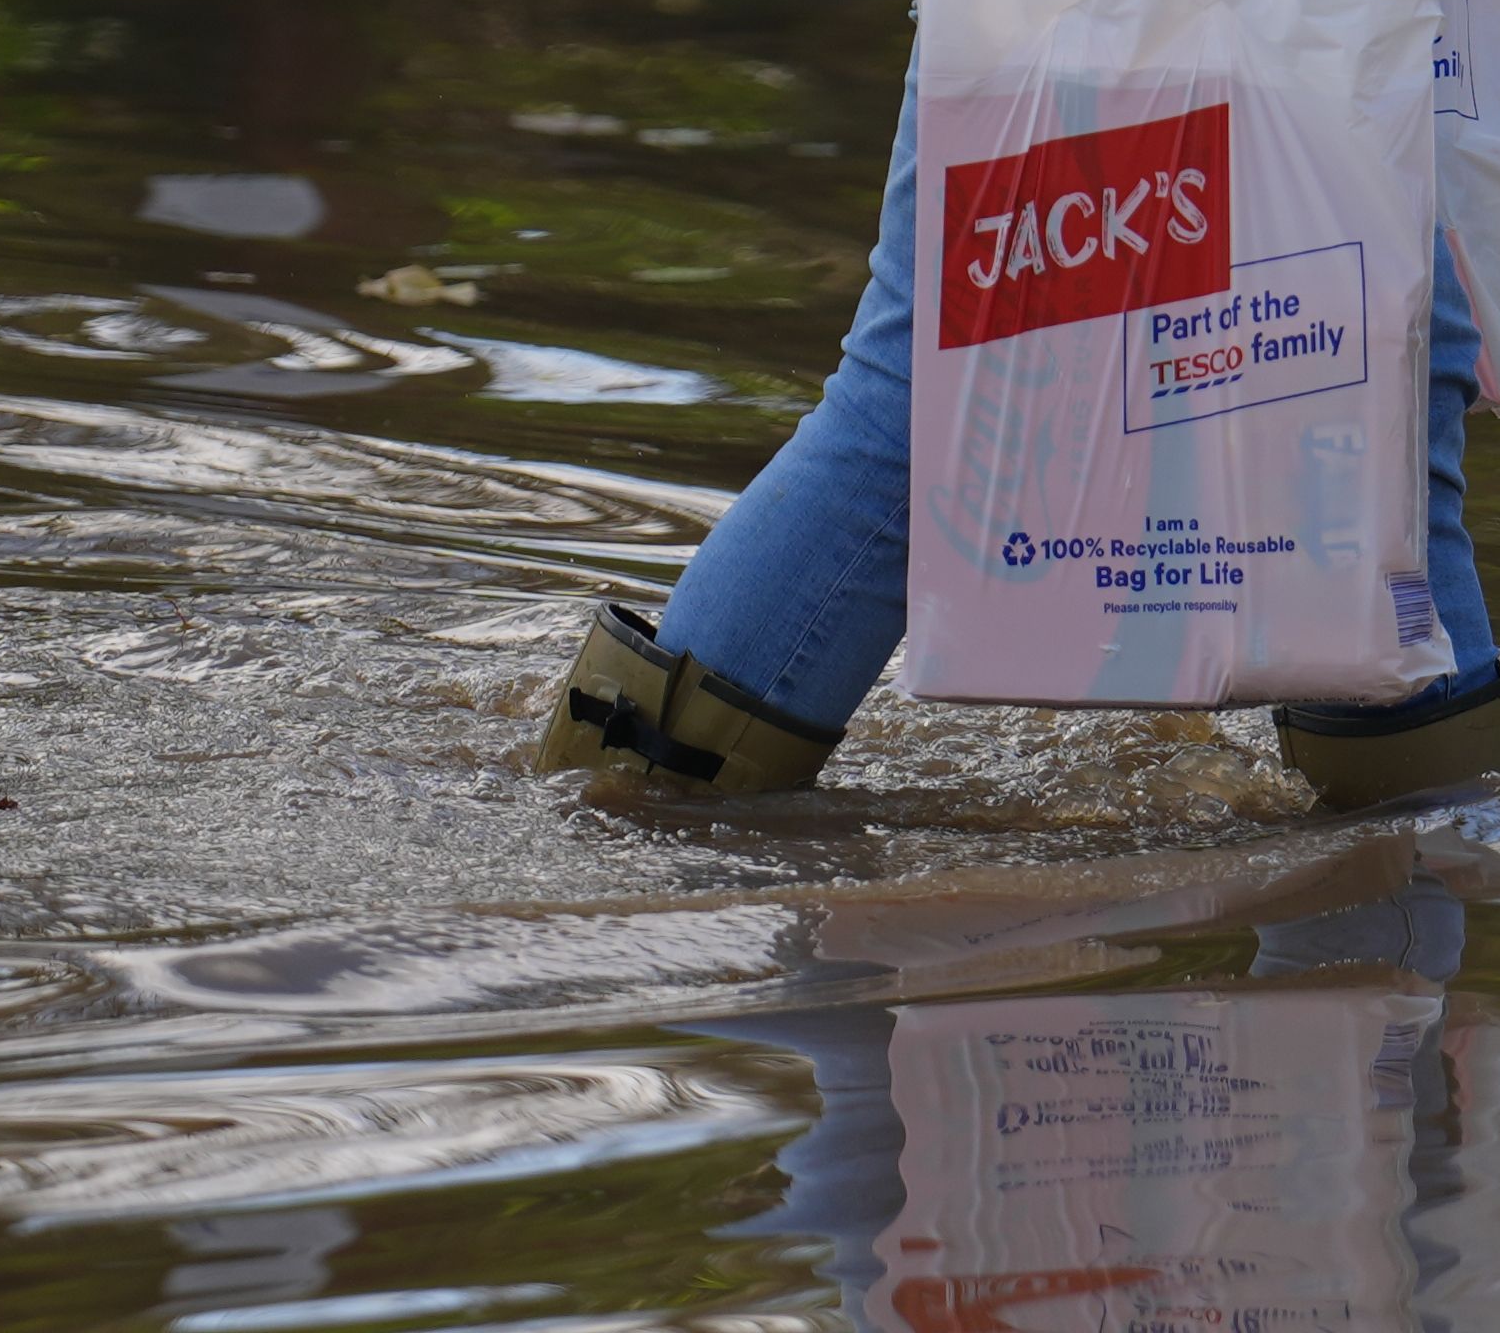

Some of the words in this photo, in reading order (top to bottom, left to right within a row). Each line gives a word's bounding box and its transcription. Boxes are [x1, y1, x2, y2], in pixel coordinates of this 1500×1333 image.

[967, 167, 1208, 290] JACK'S
[1152, 306, 1212, 344] Part
[1219, 294, 1243, 332] of
[1251, 289, 1301, 324] the
[1149, 345, 1244, 386] TESCO
[1251, 319, 1345, 365] family
[1145, 516, 1151, 533] I
[1155, 518, 1184, 532] am
[1188, 518, 1199, 531] a
[1040, 536, 1105, 560] 100%
[1110, 537, 1211, 559] Recyclable
[1215, 535, 1296, 555] Reusable
[1095, 565, 1147, 593] Bag
[1153, 562, 1193, 585] for
[1200, 561, 1245, 586] Life
[1103, 602, 1140, 614] Please
[1142, 600, 1181, 615] recycle
[1184, 598, 1238, 614] responsibly
